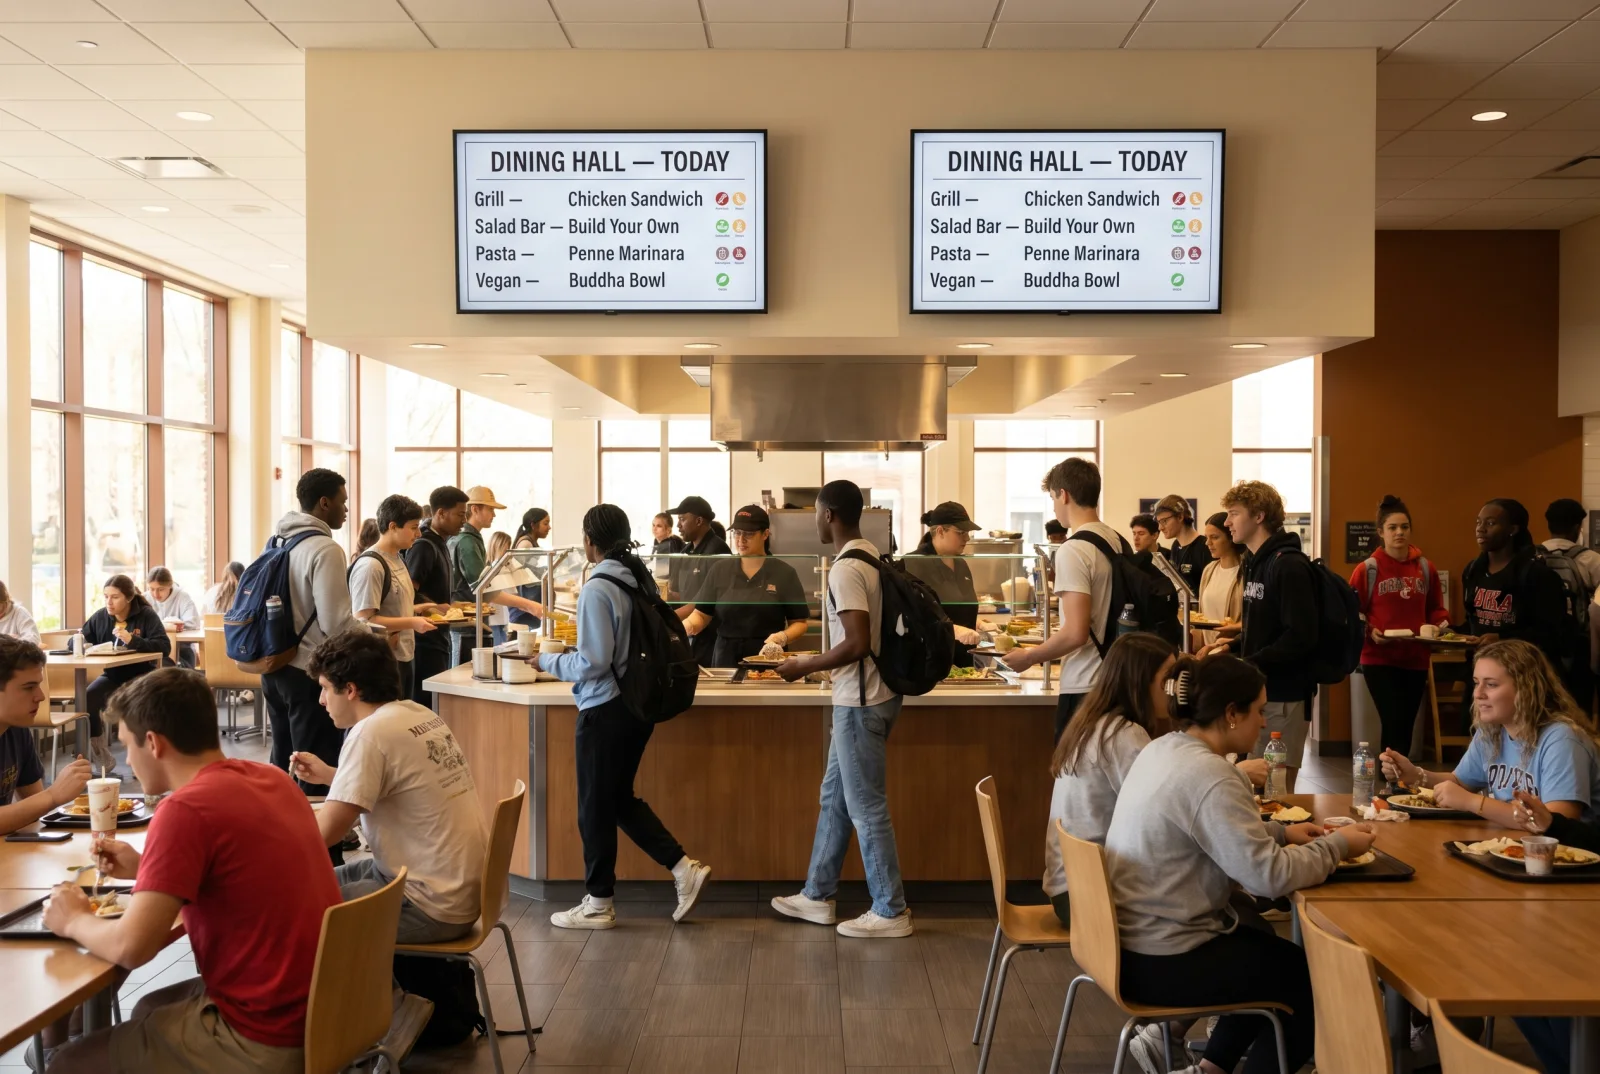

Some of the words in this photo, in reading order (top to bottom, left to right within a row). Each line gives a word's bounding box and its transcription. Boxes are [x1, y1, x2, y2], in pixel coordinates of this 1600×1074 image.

[491, 150, 565, 173] DINING
[572, 150, 626, 173] HALL
[660, 150, 730, 173] TODAY
[948, 150, 1023, 172] DINING
[1030, 150, 1084, 172] HALL
[1118, 150, 1188, 172] TODAY
[474, 190, 504, 207] Grill
[568, 190, 627, 207] Chicken
[630, 190, 703, 207] Sandwich
[930, 190, 961, 207] Grill
[1024, 190, 1083, 207] Chicken
[1087, 190, 1160, 207] Sandwich
[475, 217, 516, 235] Salad
[520, 218, 546, 234] Bar
[568, 217, 606, 234] Build
[609, 218, 643, 234] Your
[647, 218, 679, 234] Own
[930, 217, 972, 234] Salad
[976, 218, 1002, 234] Bar
[1024, 217, 1062, 234] Build
[1065, 218, 1099, 234] Your
[1102, 217, 1135, 234] Own
[475, 245, 516, 261] Pasta
[569, 245, 615, 261] Penne
[619, 244, 685, 261] Marinara
[930, 245, 971, 261] Pasta
[1024, 245, 1070, 261] Penne
[1074, 244, 1140, 261] Marinara
[475, 272, 521, 292] Vegan
[569, 271, 625, 288] Buddha
[629, 271, 665, 288] Bowl
[929, 272, 976, 292] Vegan
[1024, 271, 1080, 288] Buddha
[1084, 271, 1120, 288] Bowl
